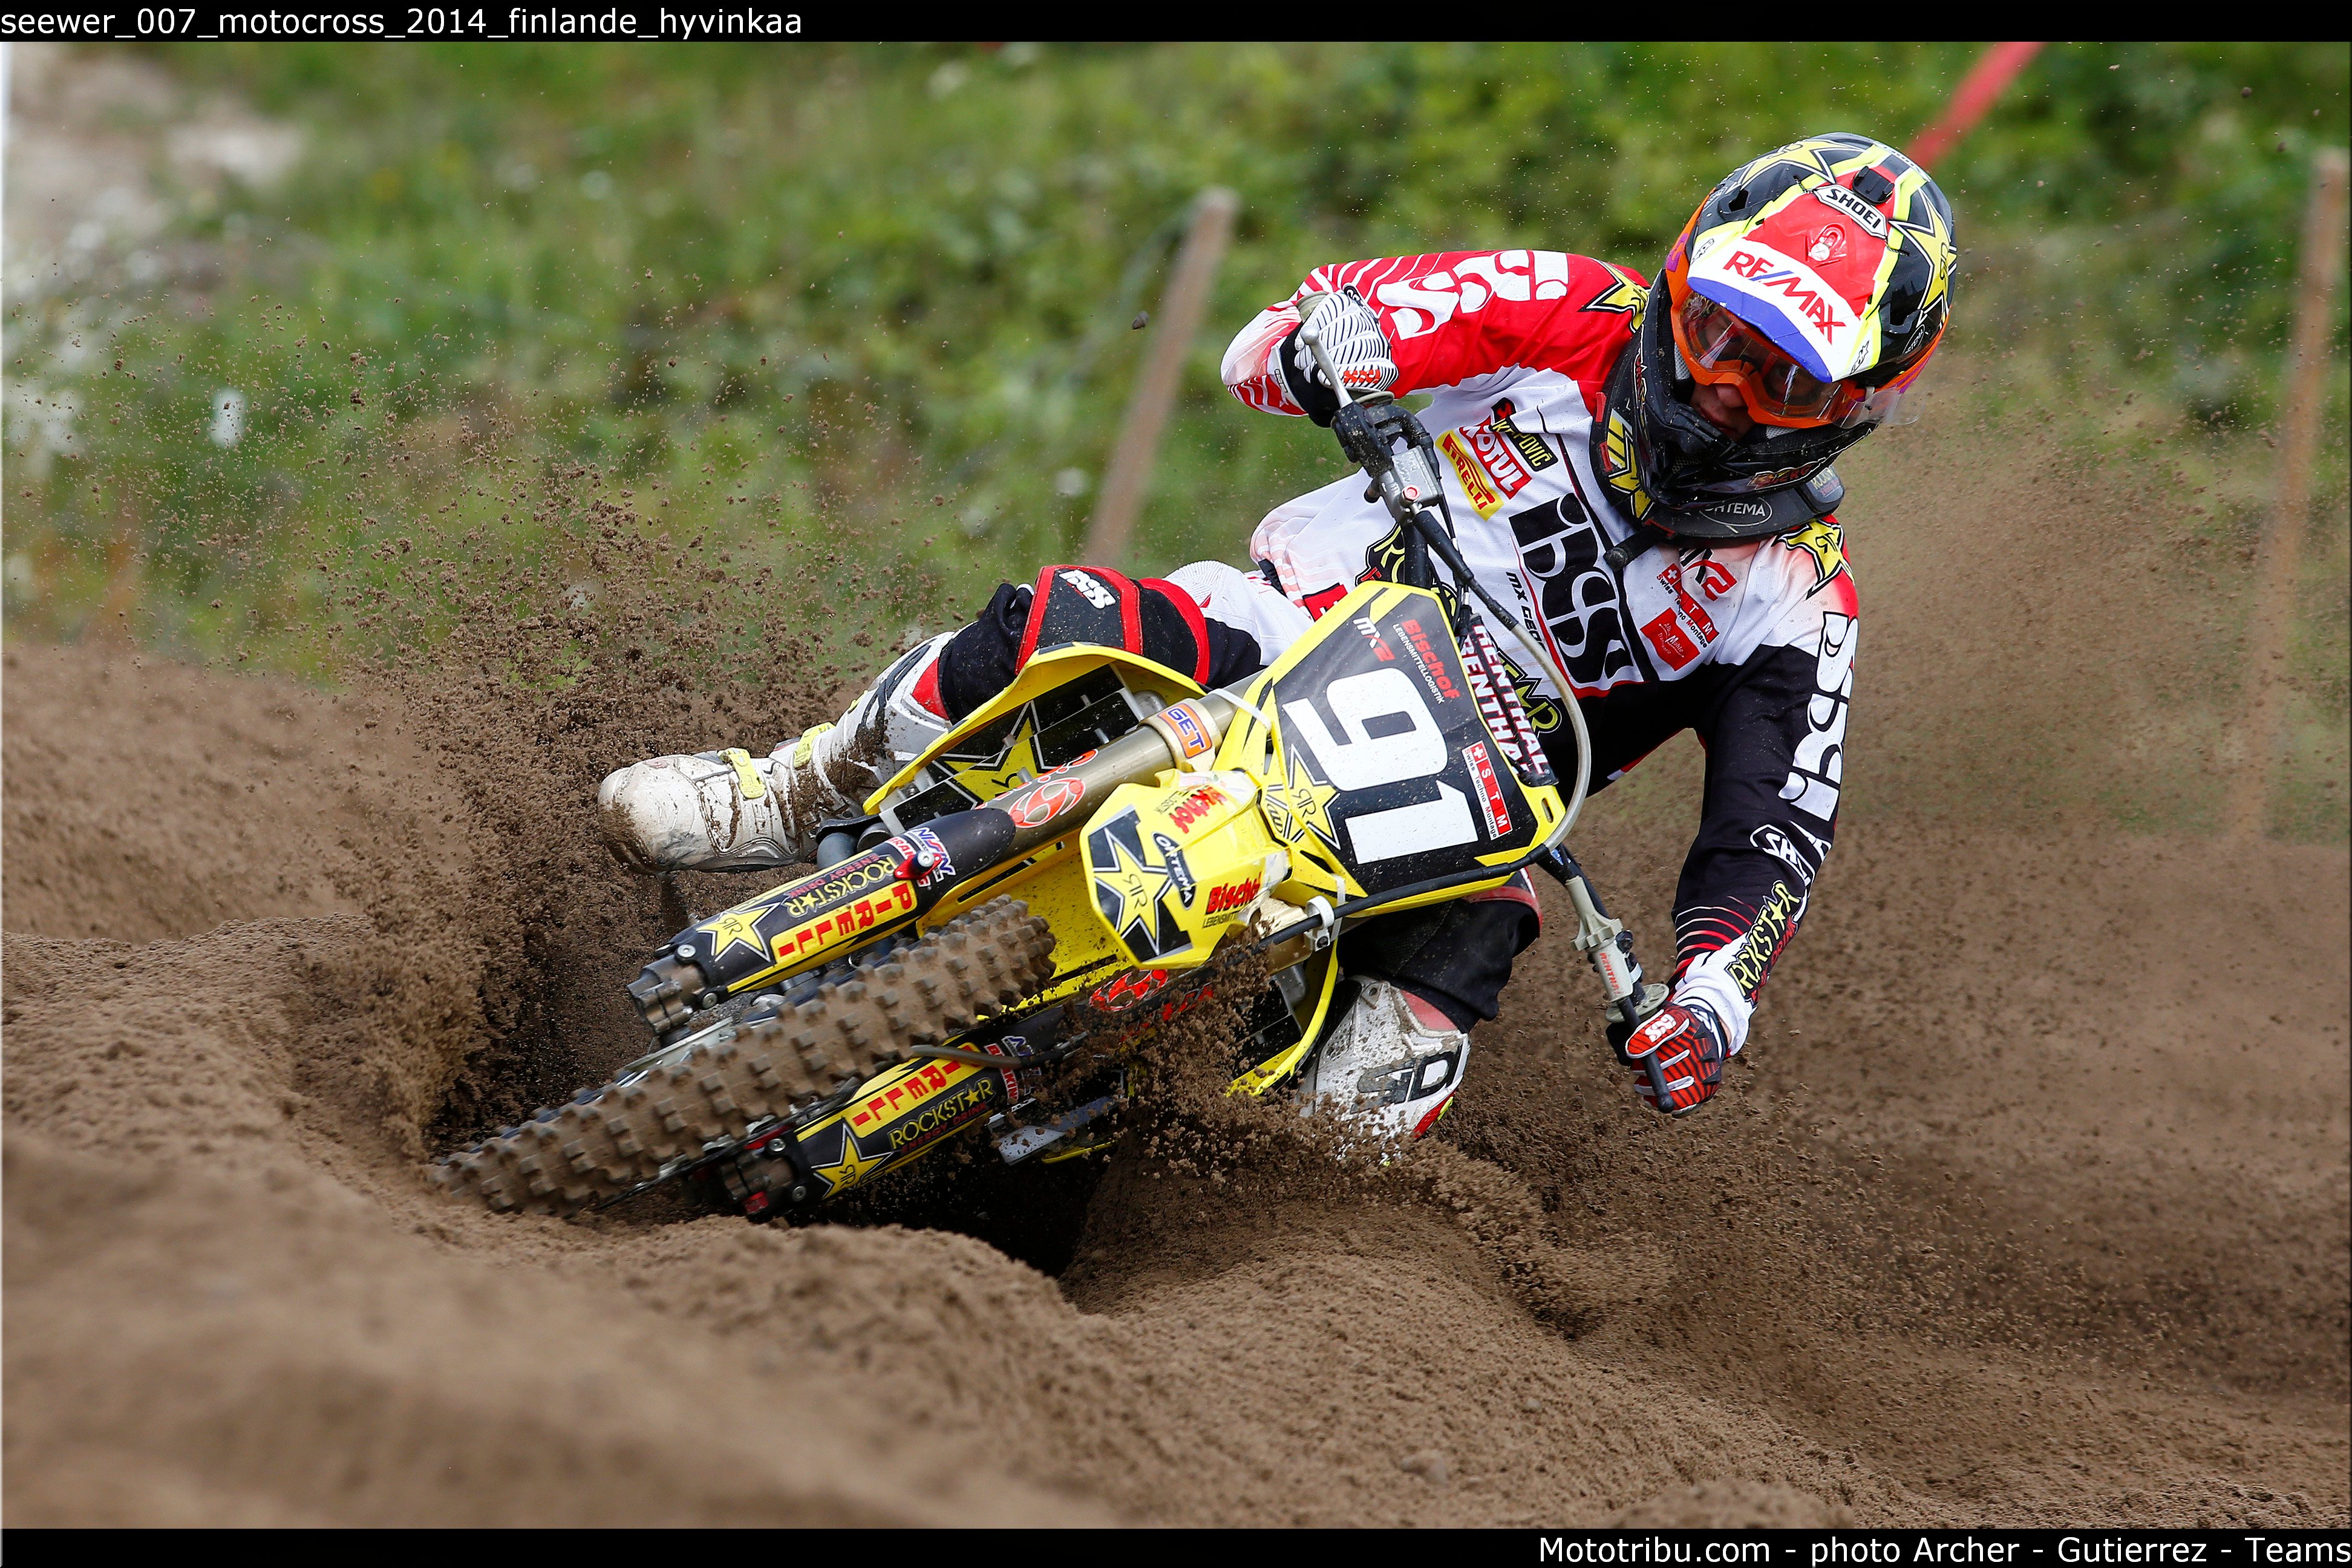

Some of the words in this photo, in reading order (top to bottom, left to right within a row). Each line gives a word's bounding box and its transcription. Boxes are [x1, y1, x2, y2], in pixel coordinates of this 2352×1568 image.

[1825, 187, 1882, 229] SHOEI
[1723, 251, 1846, 345] RE/MAX
[1442, 433, 1496, 510] PIRELLI
[1393, 623, 1445, 704] LEBENSMITTELLOGISTIK
[1401, 619, 1461, 699] Bischof
[1166, 708, 1205, 752] GET
[1472, 624, 1549, 775] RENTHAL
[1282, 668, 1478, 865] 91
[1485, 806, 1497, 838] Montage
[778, 883, 912, 957] PIRELLI
